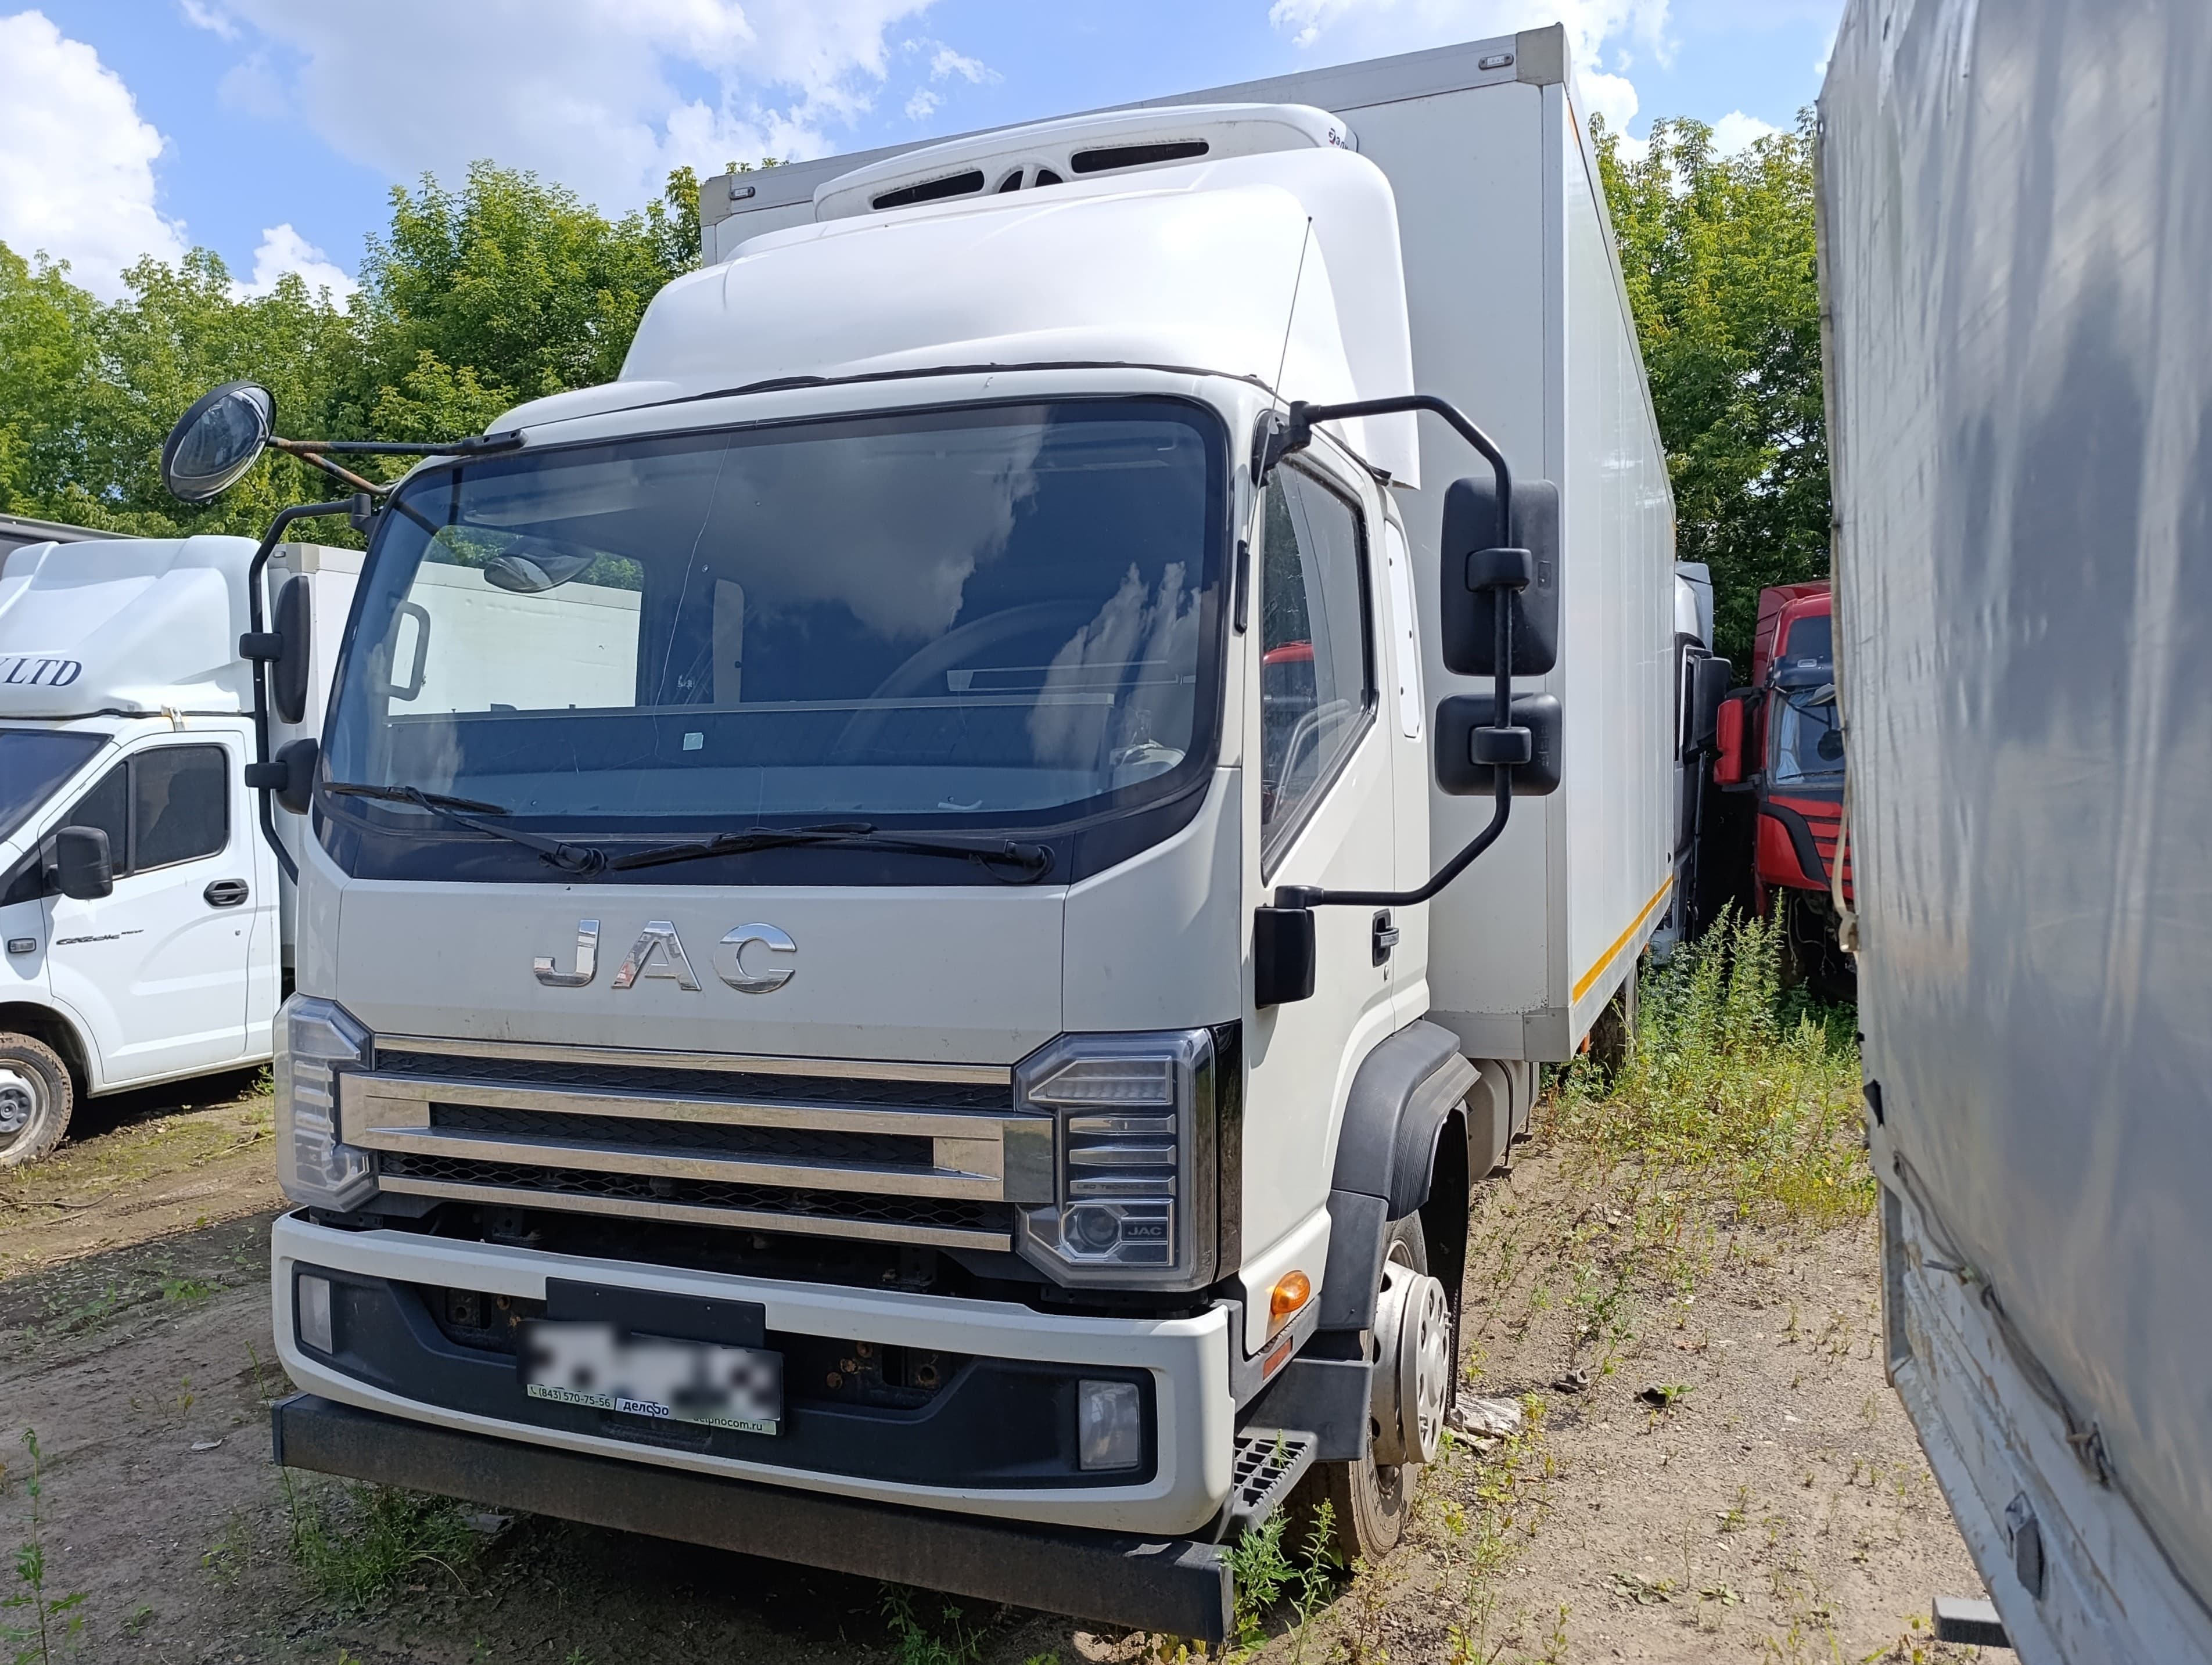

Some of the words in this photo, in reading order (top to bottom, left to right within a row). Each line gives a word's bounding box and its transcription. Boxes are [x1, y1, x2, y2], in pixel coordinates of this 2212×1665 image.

[2, 657, 82, 687] LTD
[534, 919, 798, 994] JAC
[1128, 1227, 1162, 1236] JAC
[538, 1387, 562, 1400] (843)
[563, 1393, 611, 1408] 570-75-56
